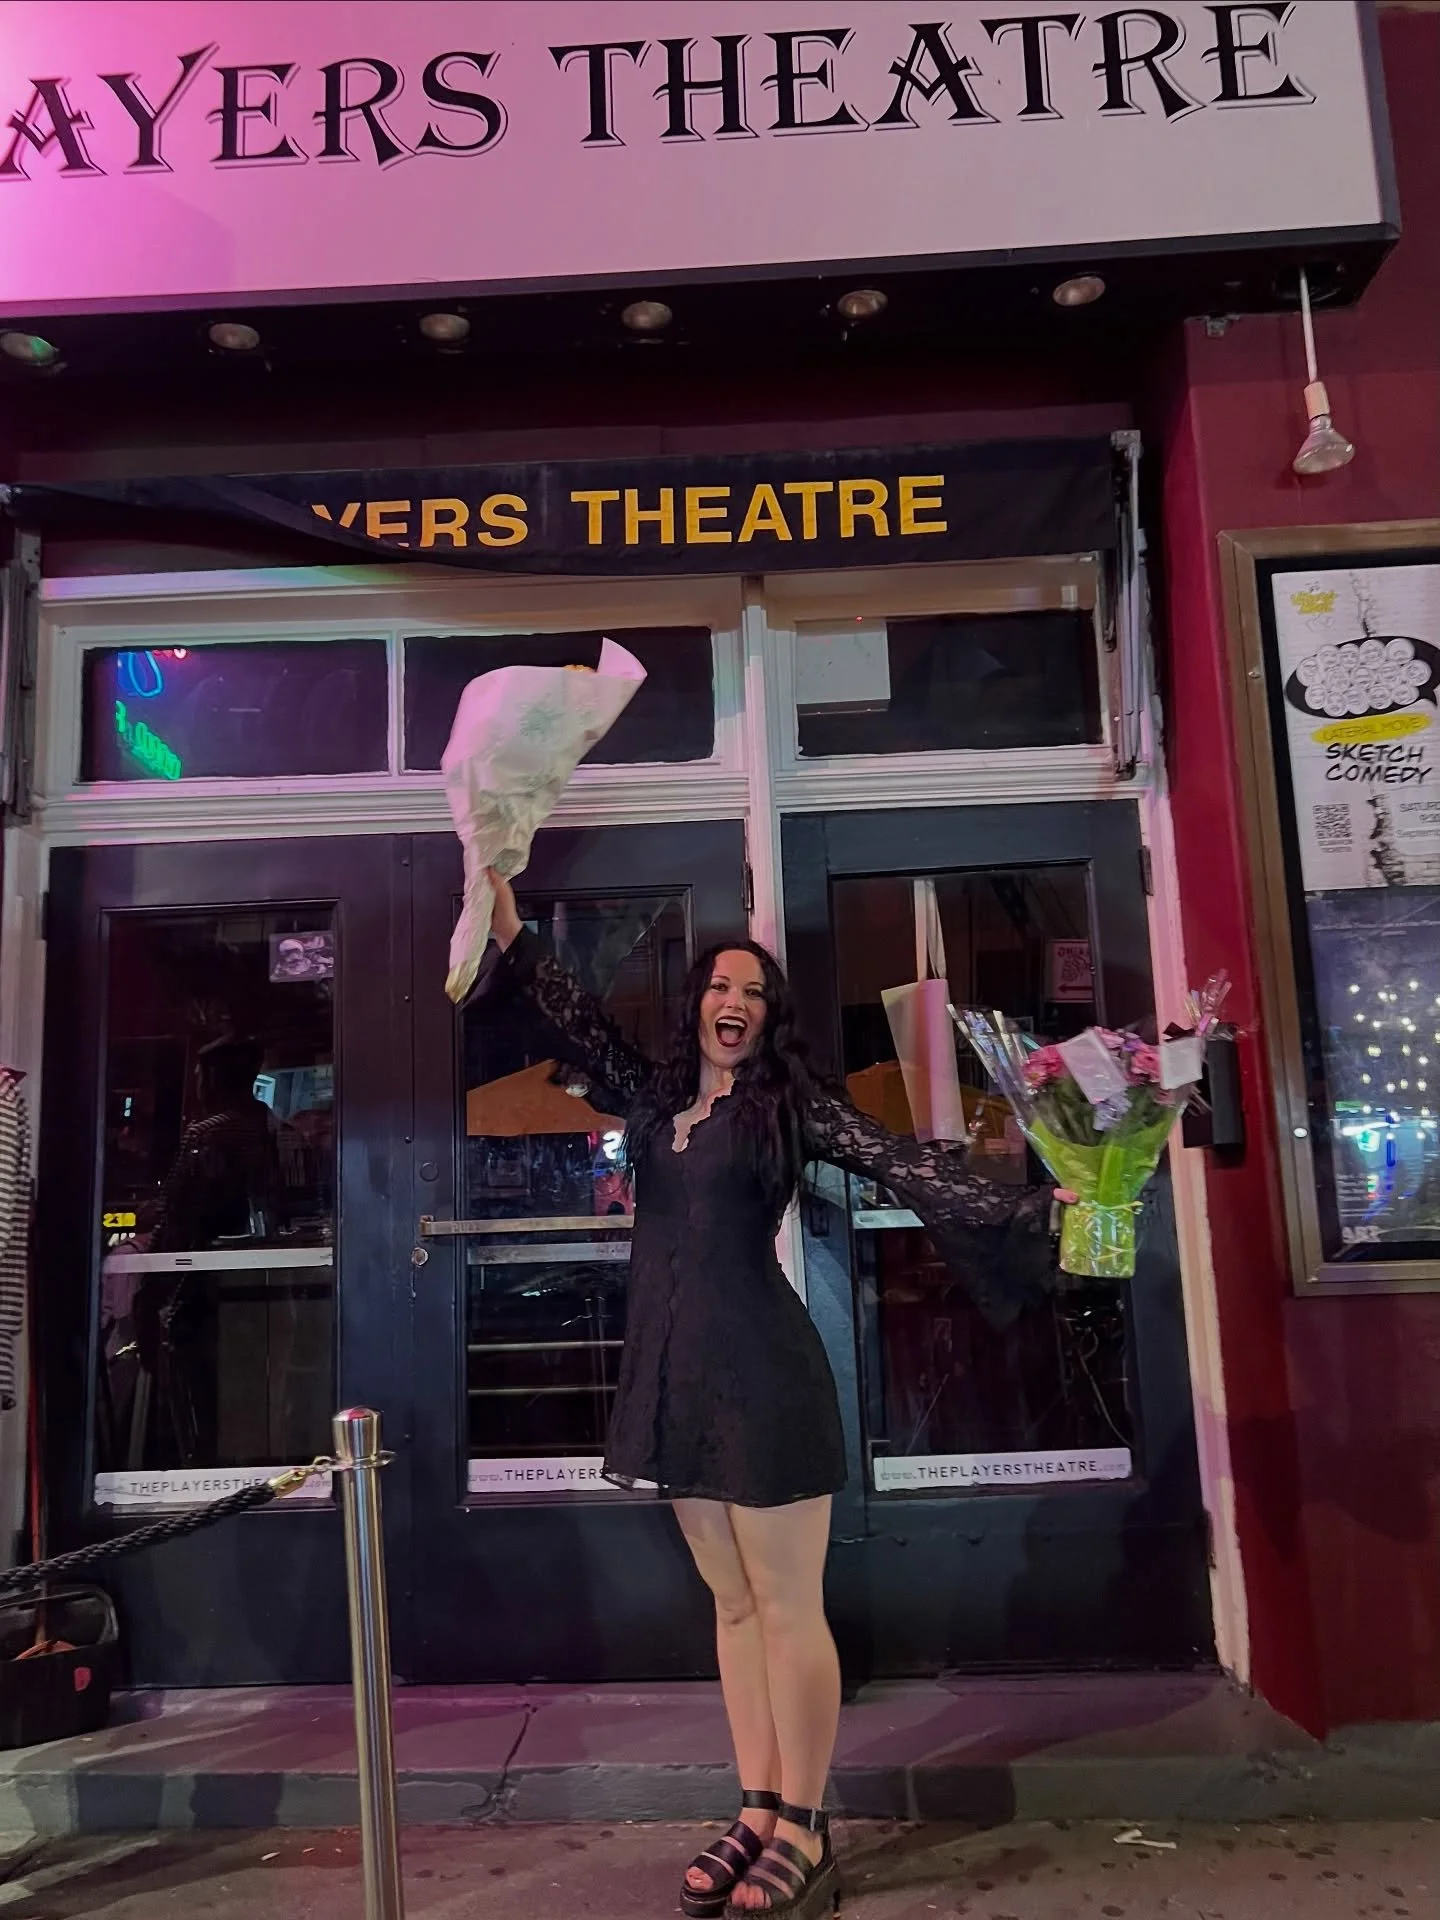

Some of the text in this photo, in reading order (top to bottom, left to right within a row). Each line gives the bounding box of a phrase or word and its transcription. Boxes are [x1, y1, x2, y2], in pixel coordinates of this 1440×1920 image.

[0, 1, 1317, 181] AYERS THEATRE
[570, 475, 948, 545] THEATRE
[1325, 742, 1425, 763] SKETCH
[1325, 763, 1433, 784] COMEDY
